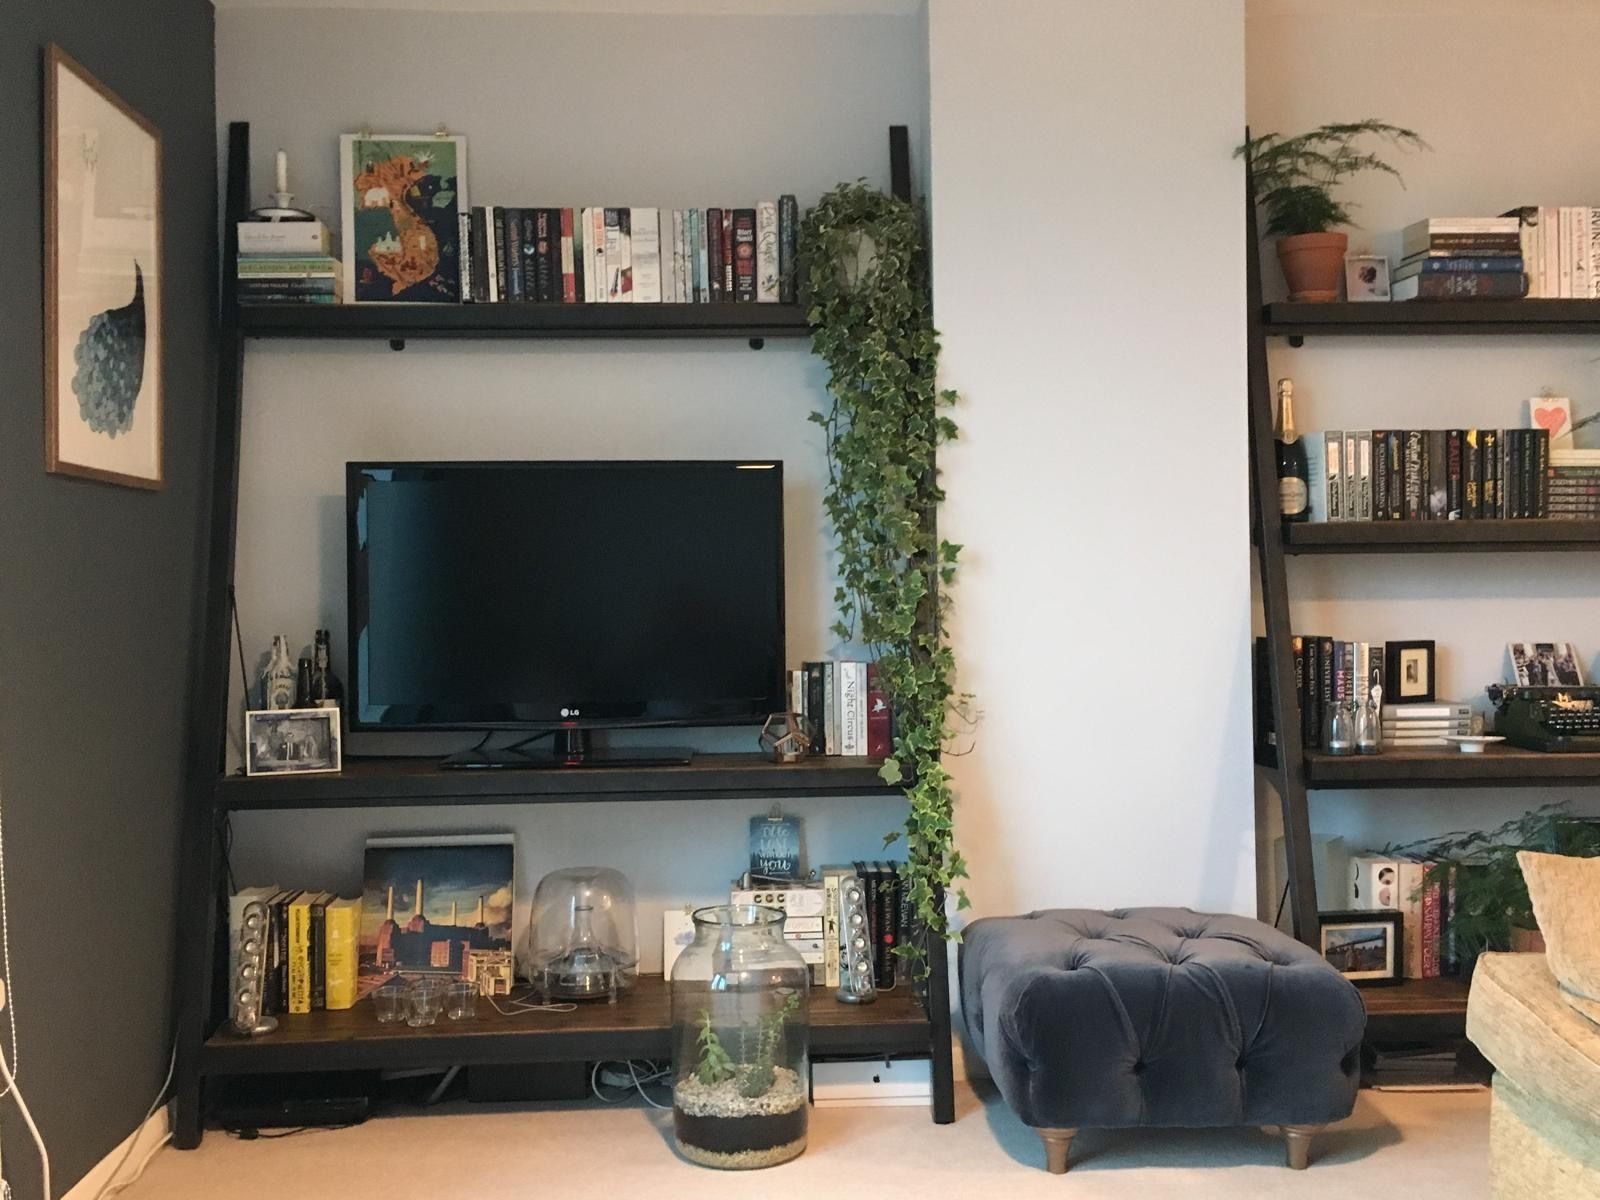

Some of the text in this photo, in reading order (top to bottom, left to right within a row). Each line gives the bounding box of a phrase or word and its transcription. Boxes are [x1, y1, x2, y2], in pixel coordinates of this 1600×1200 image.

[1336, 670, 1345, 699] MAUS
[845, 681, 855, 740] Night Circus
[760, 859, 791, 875] you
